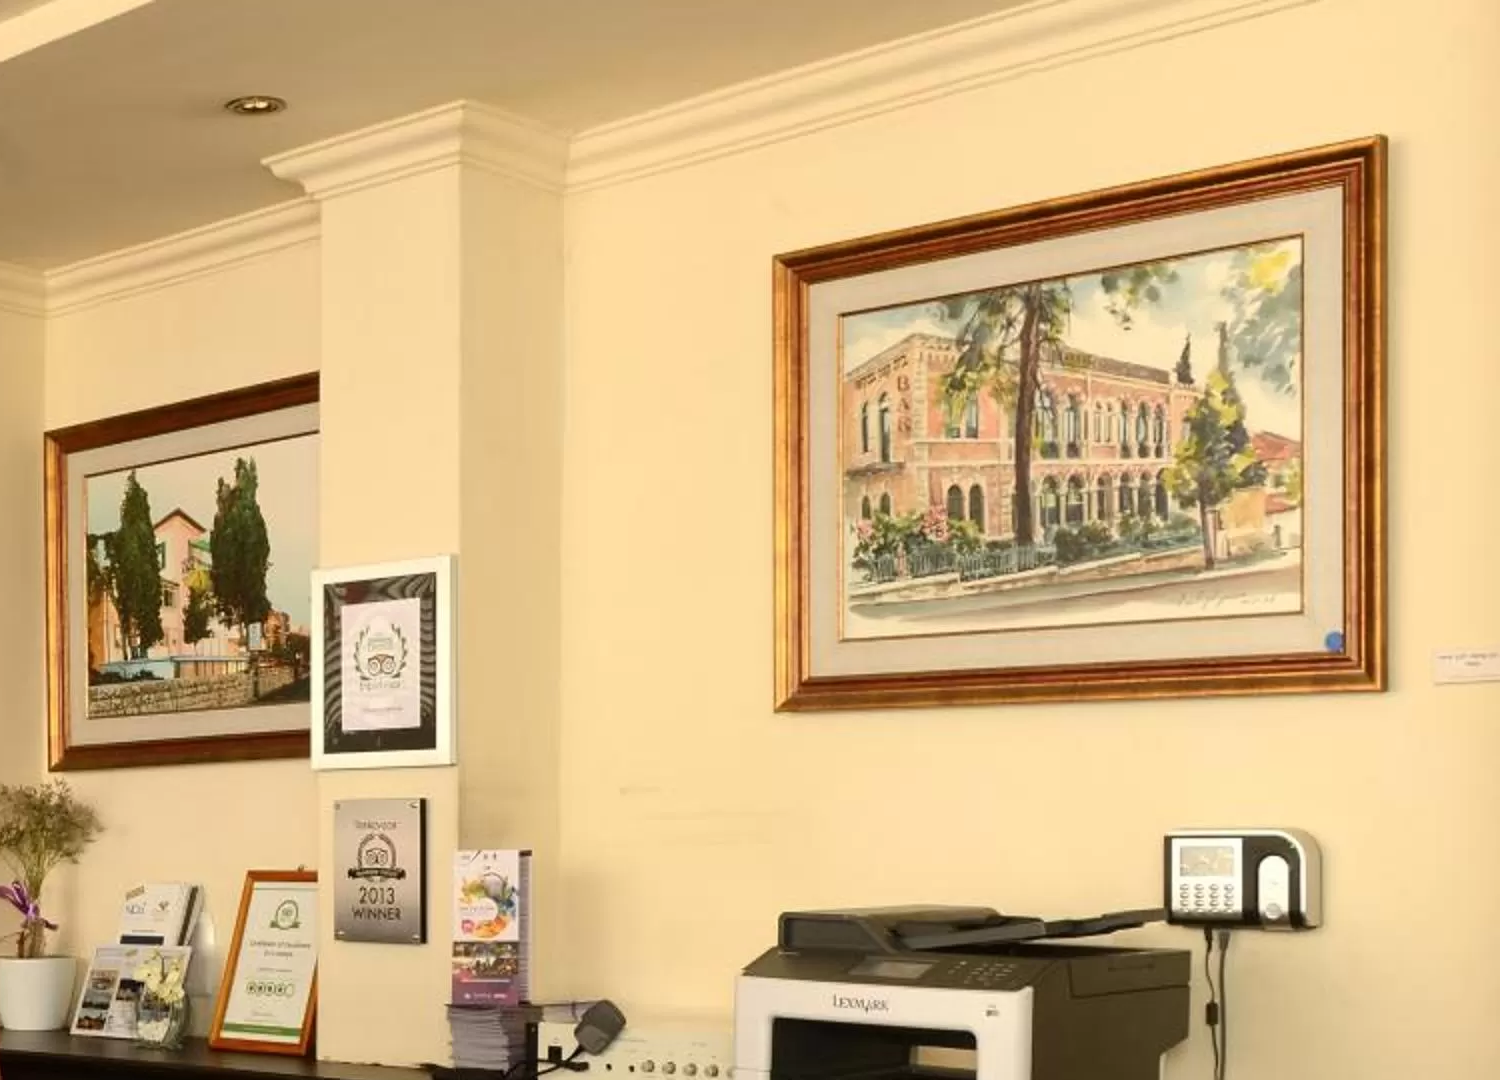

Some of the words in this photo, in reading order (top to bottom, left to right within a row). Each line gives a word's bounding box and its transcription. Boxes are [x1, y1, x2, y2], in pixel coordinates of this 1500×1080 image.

[359, 887, 395, 905] 2013
[352, 907, 401, 920] WINNER
[832, 993, 890, 1015] LEXMARK
